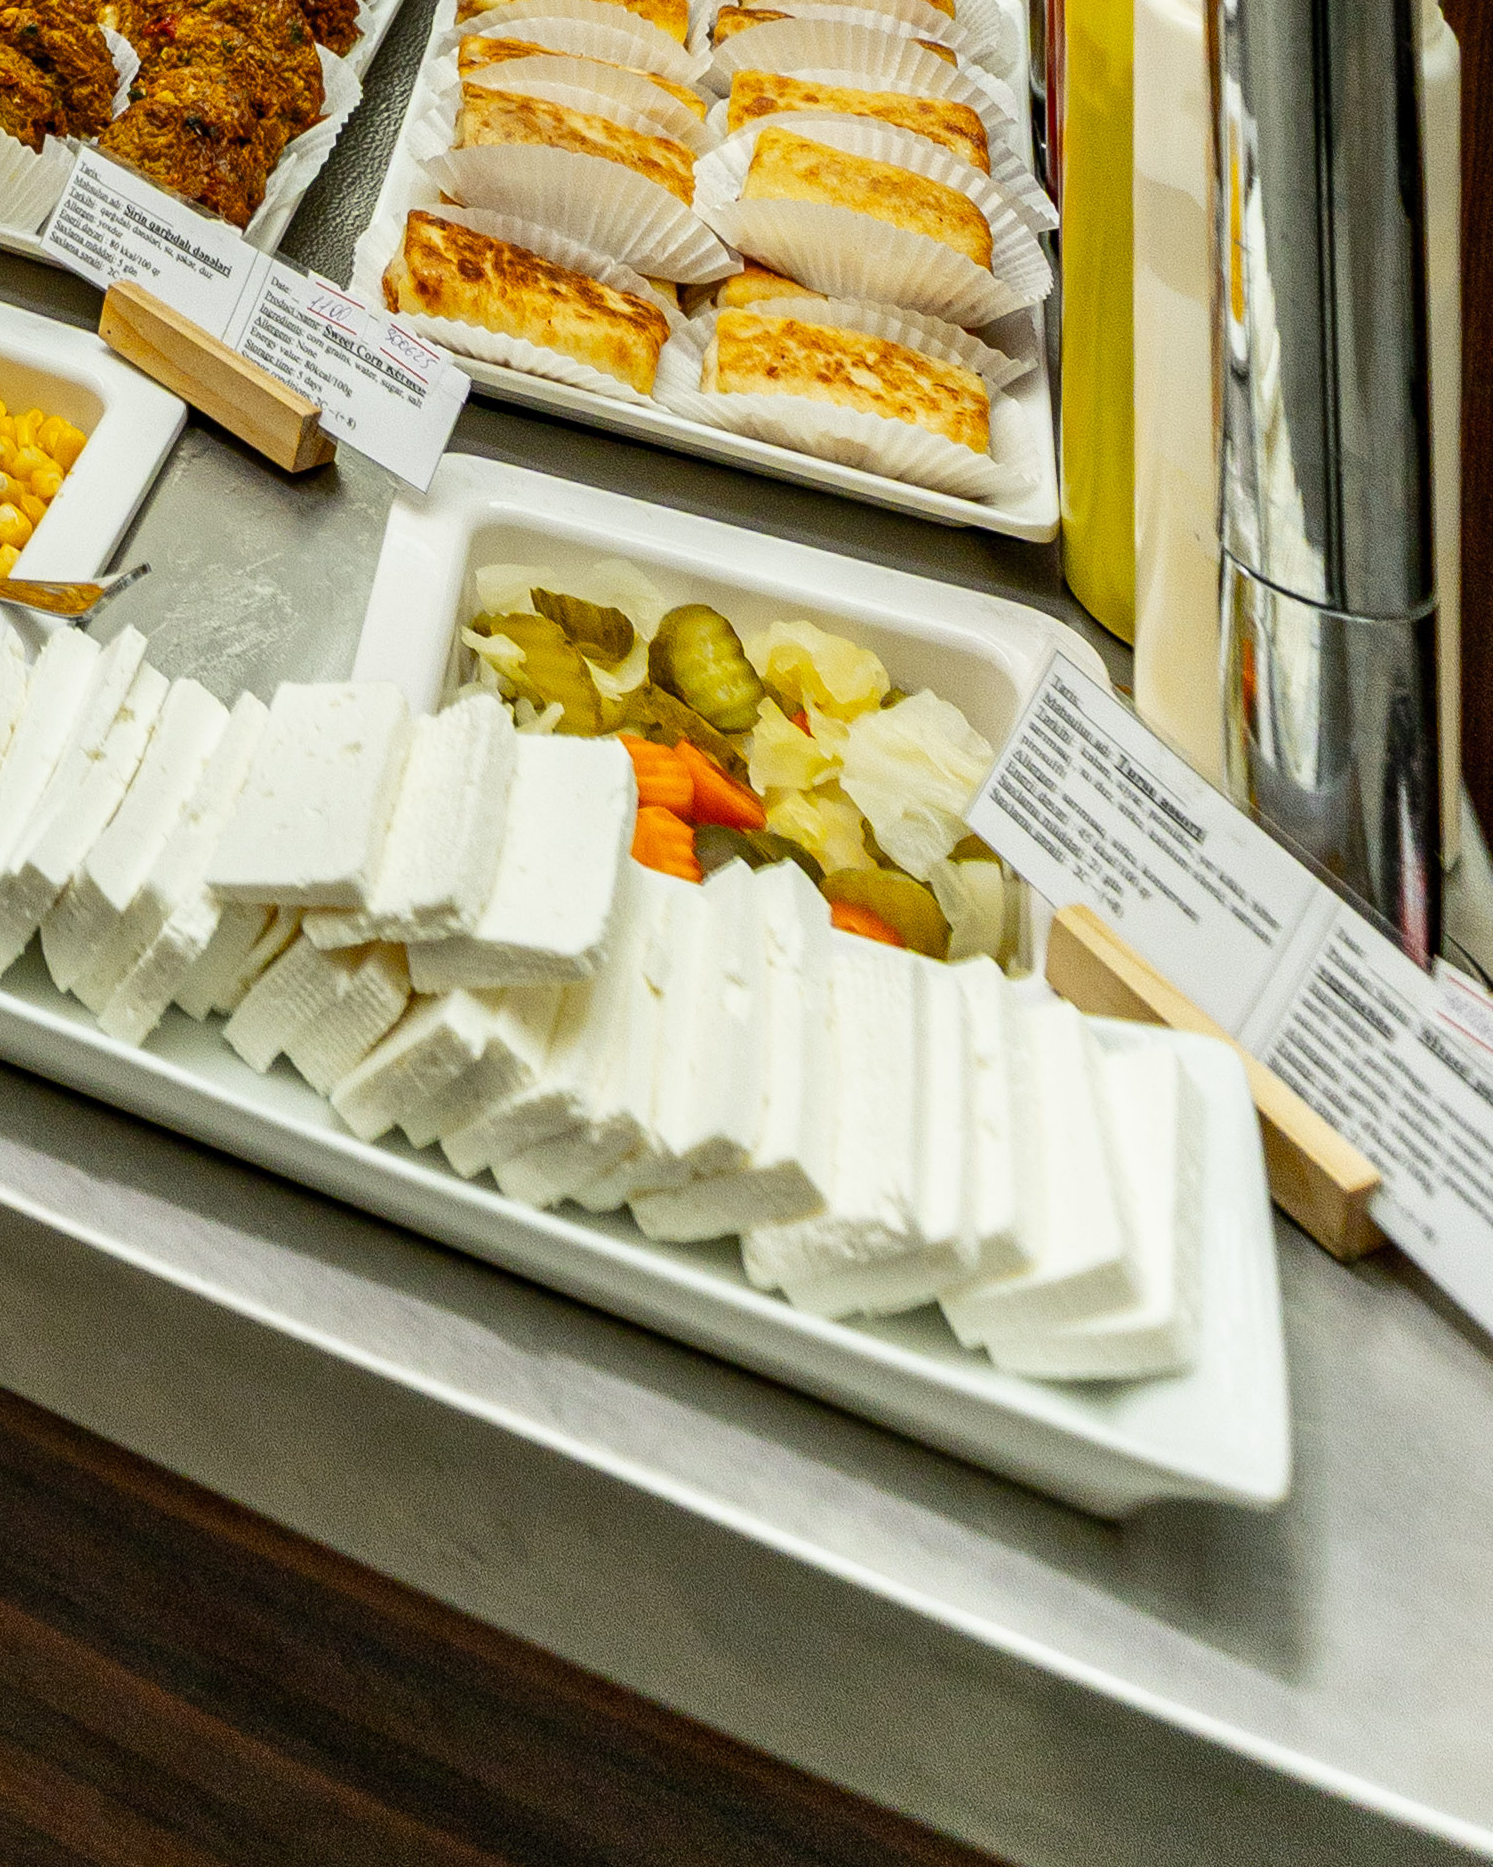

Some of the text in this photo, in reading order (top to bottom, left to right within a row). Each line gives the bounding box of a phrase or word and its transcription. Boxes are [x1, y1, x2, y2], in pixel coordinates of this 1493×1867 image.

[263, 289, 295, 316] Product
[321, 323, 354, 353] Sweet
[353, 343, 383, 371] Corn
